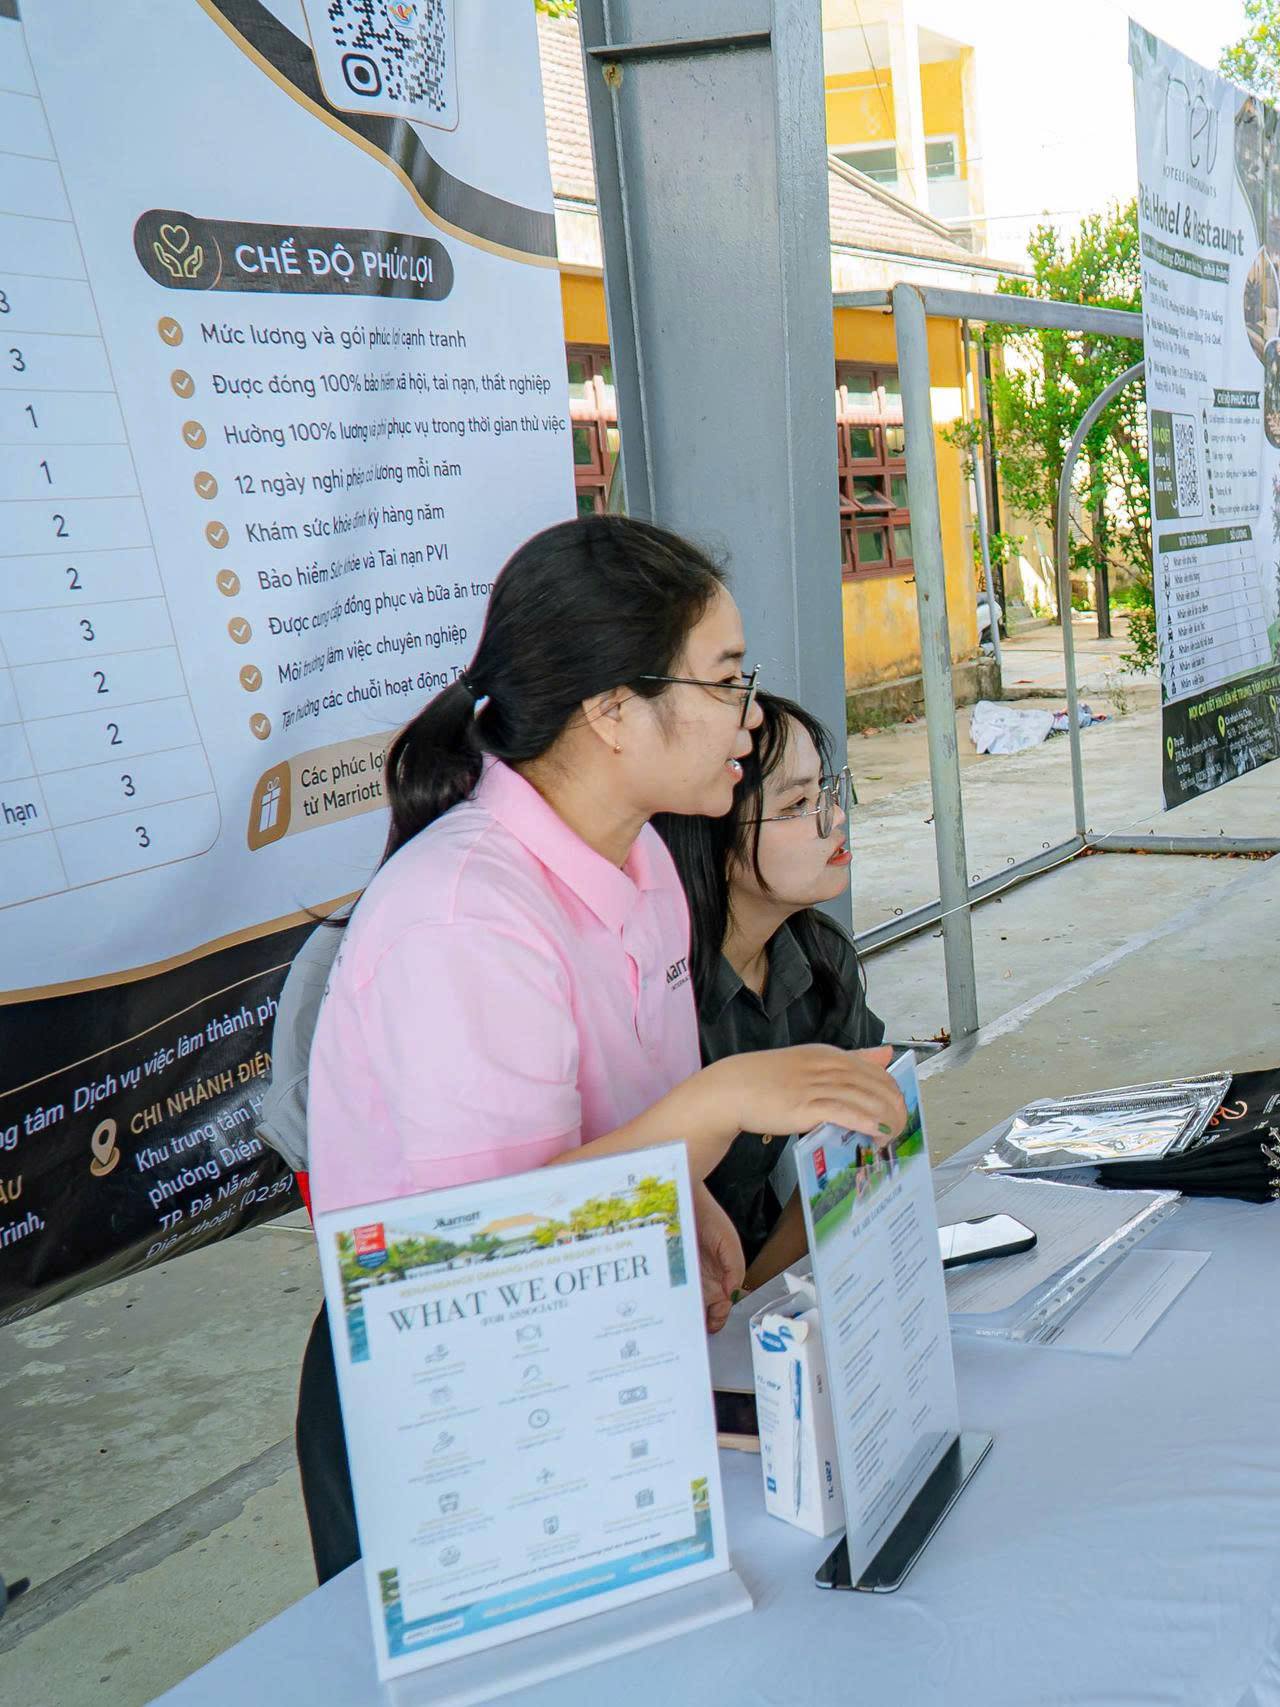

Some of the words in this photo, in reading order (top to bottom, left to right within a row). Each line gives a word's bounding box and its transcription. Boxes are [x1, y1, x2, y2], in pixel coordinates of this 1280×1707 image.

[1152, 194, 1180, 235] Hotel
[1184, 206, 1191, 239] &
[235, 237, 302, 275] CHẾ
[307, 243, 354, 283] ĐỘ
[362, 247, 407, 280] PHÚC
[410, 255, 433, 288] LỢI
[200, 322, 245, 344] Mức
[250, 324, 307, 350] lương
[312, 326, 335, 344] và
[340, 325, 366, 350] gói
[369, 326, 391, 350] phúc
[402, 328, 425, 350] cạnh
[430, 330, 467, 347] tranh
[9, 348, 26, 372] 3
[212, 374, 263, 399] Được
[268, 374, 316, 398] đóng
[320, 374, 362, 392] 100%
[396, 374, 406, 390] xã
[409, 372, 430, 394] hội,
[433, 373, 449, 391] tai
[452, 376, 479, 395] nạn,
[481, 370, 507, 391] thất
[509, 373, 551, 395] nghiệp
[25, 404, 38, 429] 1
[224, 424, 285, 447] Hưởng
[288, 422, 337, 442] 100%
[339, 421, 368, 442] lương
[387, 417, 412, 439] phục
[414, 421, 429, 438] vụ
[432, 418, 466, 437] trong
[468, 416, 491, 433] thời
[494, 417, 518, 436] gian
[541, 415, 566, 434] việc
[40, 460, 52, 485] 1
[234, 474, 256, 494] 12
[261, 472, 306, 497] ngày
[374, 464, 403, 484] lương
[406, 457, 430, 478] mỗi
[434, 460, 462, 477] năm
[52, 514, 69, 537] 2
[246, 521, 298, 543] Khám
[303, 518, 331, 538] sức
[382, 505, 413, 526] hàng
[417, 504, 445, 521] năm
[66, 567, 82, 590] 2
[257, 568, 293, 590] Bảo
[296, 561, 329, 586] hiểm
[363, 552, 376, 569] và
[378, 549, 397, 567] Tai
[400, 550, 424, 568] nạn
[426, 543, 448, 561] PVI
[268, 616, 310, 637] Được
[344, 594, 372, 616] đồng
[375, 592, 407, 614] phục
[409, 586, 424, 604] và
[426, 584, 450, 602] bữa
[454, 583, 468, 599] ăn
[471, 581, 495, 596] tron
[80, 619, 95, 641] 3
[278, 661, 302, 684] Môi
[326, 646, 344, 665] làm
[347, 640, 373, 661] việc
[376, 632, 422, 655] chuyên
[425, 624, 467, 649] nghiệp
[93, 671, 109, 693] 2
[282, 711, 295, 735] Tận
[322, 690, 343, 709] các
[346, 679, 382, 703] chuỗi
[384, 676, 413, 697] hoạt
[417, 672, 448, 692] động
[106, 723, 123, 745] 2
[120, 774, 136, 796] 3
[301, 766, 328, 788] Các
[331, 755, 366, 784] phúc
[370, 750, 386, 778] lợi
[323, 780, 382, 811] Marriott
[1, 802, 38, 826] hạn
[135, 826, 151, 847] 3
[24, 1103, 65, 1136] tâm
[73, 1075, 117, 1113] Dịch
[120, 1068, 141, 1089] vụ
[144, 1048, 175, 1075] việc
[177, 1031, 204, 1059] làm
[206, 1006, 255, 1042] thành
[257, 996, 278, 1026] ph
[130, 1103, 163, 1134] CHI
[167, 1069, 234, 1117] NHÁNH
[135, 1148, 170, 1172] Khu
[171, 1123, 218, 1154] trung
[217, 1108, 250, 1131] tâm
[148, 1159, 220, 1209] phường
[219, 1137, 263, 1168] Điện
[240, 1173, 294, 1212] (0235)
[389, 1290, 487, 1333] WHAT
[498, 1277, 546, 1308] WE
[555, 1254, 650, 1296] OFFER
